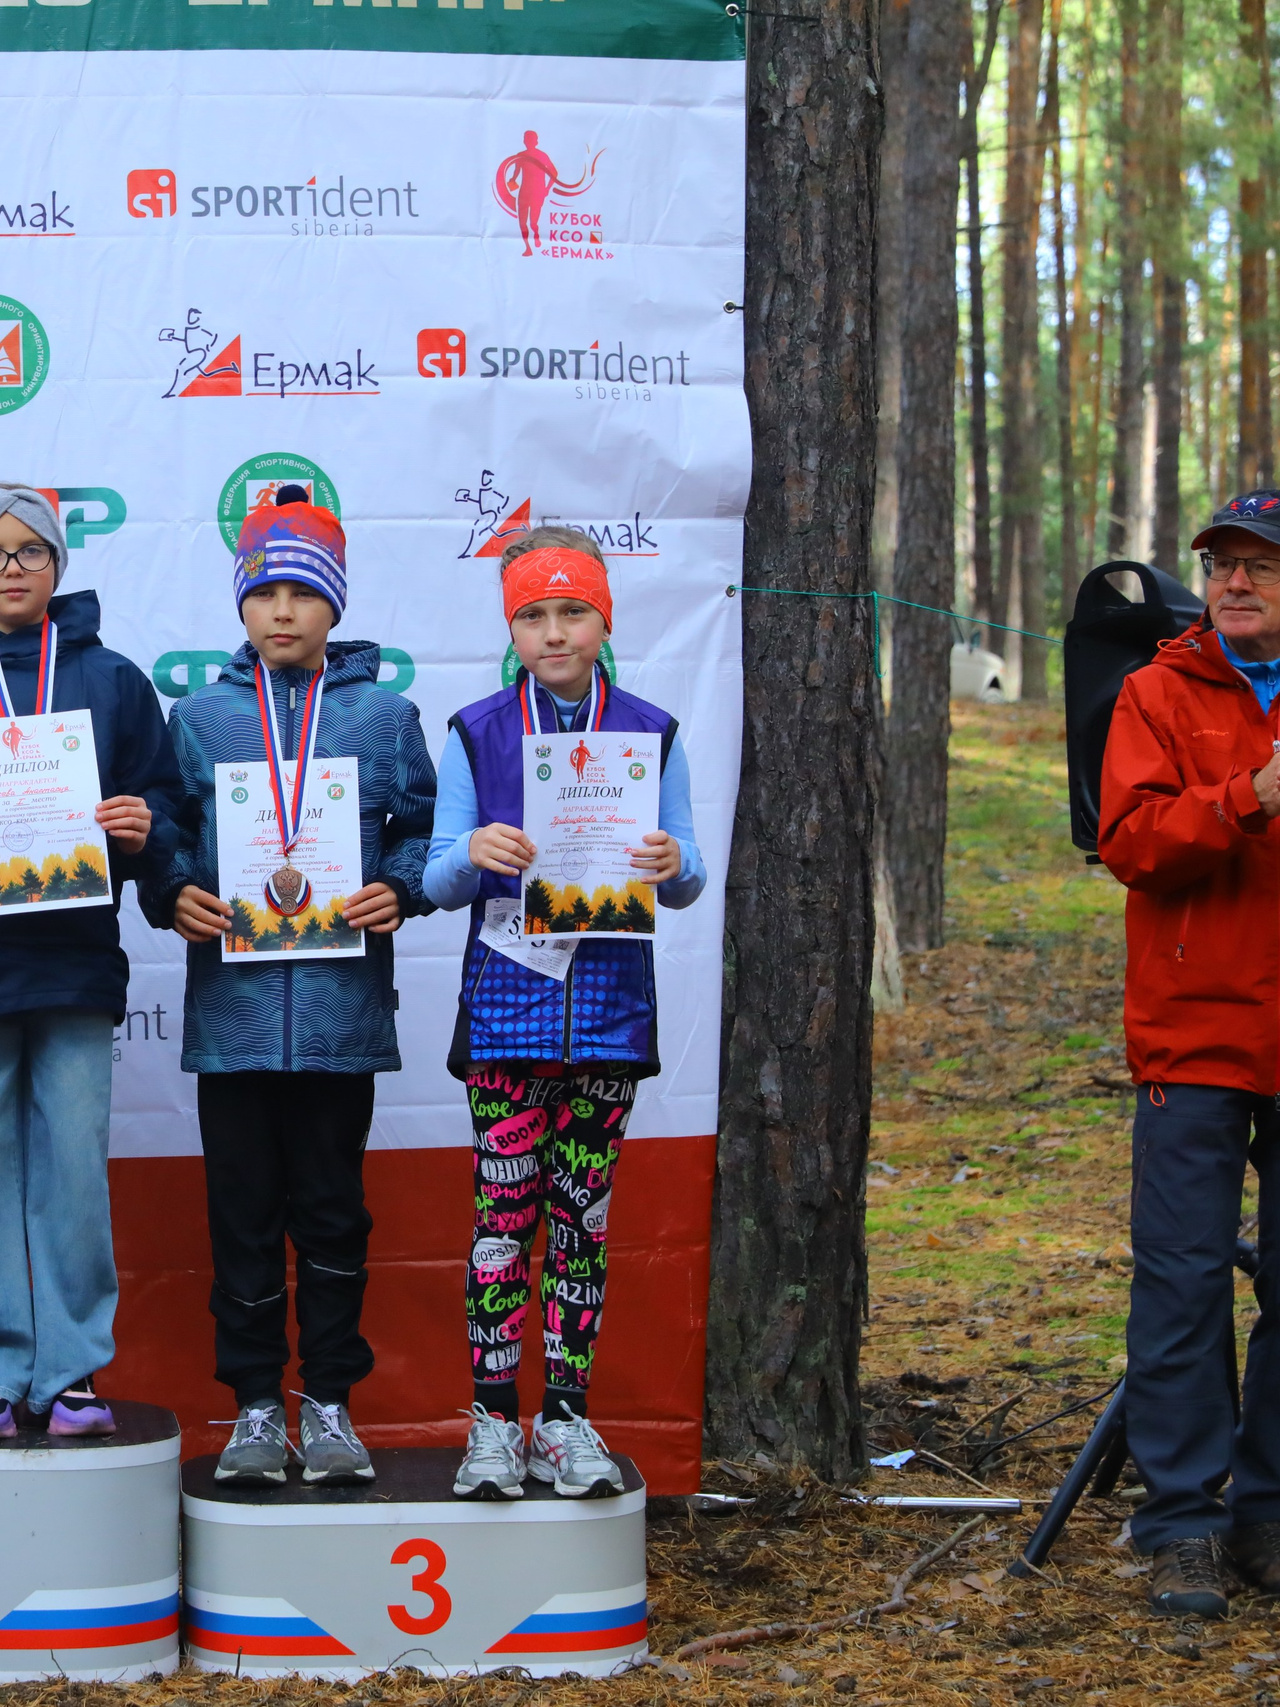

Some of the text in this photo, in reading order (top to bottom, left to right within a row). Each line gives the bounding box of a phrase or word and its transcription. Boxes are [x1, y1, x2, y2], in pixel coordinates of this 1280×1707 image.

[191, 175, 419, 218] SPORTident
[291, 219, 374, 237] siberia
[549, 212, 602, 227] КУБОК
[549, 230, 583, 242] КСО
[541, 246, 614, 260] «ЕРМАК»
[20, 322, 44, 397] ОРИЕНТИРОВАНИЯ
[480, 340, 690, 386] SPORTident
[253, 349, 379, 398] Ермак
[575, 384, 652, 401] siberia
[223, 469, 251, 516] ФЕДЕРАЦИЯ
[255, 458, 316, 477] СПОРТИВНОГО
[0, 777, 57, 788] НАГРАЖДАЕТСЯ
[557, 786, 624, 801] ДИПЛОМ
[471, 1087, 514, 1118] love
[387, 1539, 452, 1635] 3
